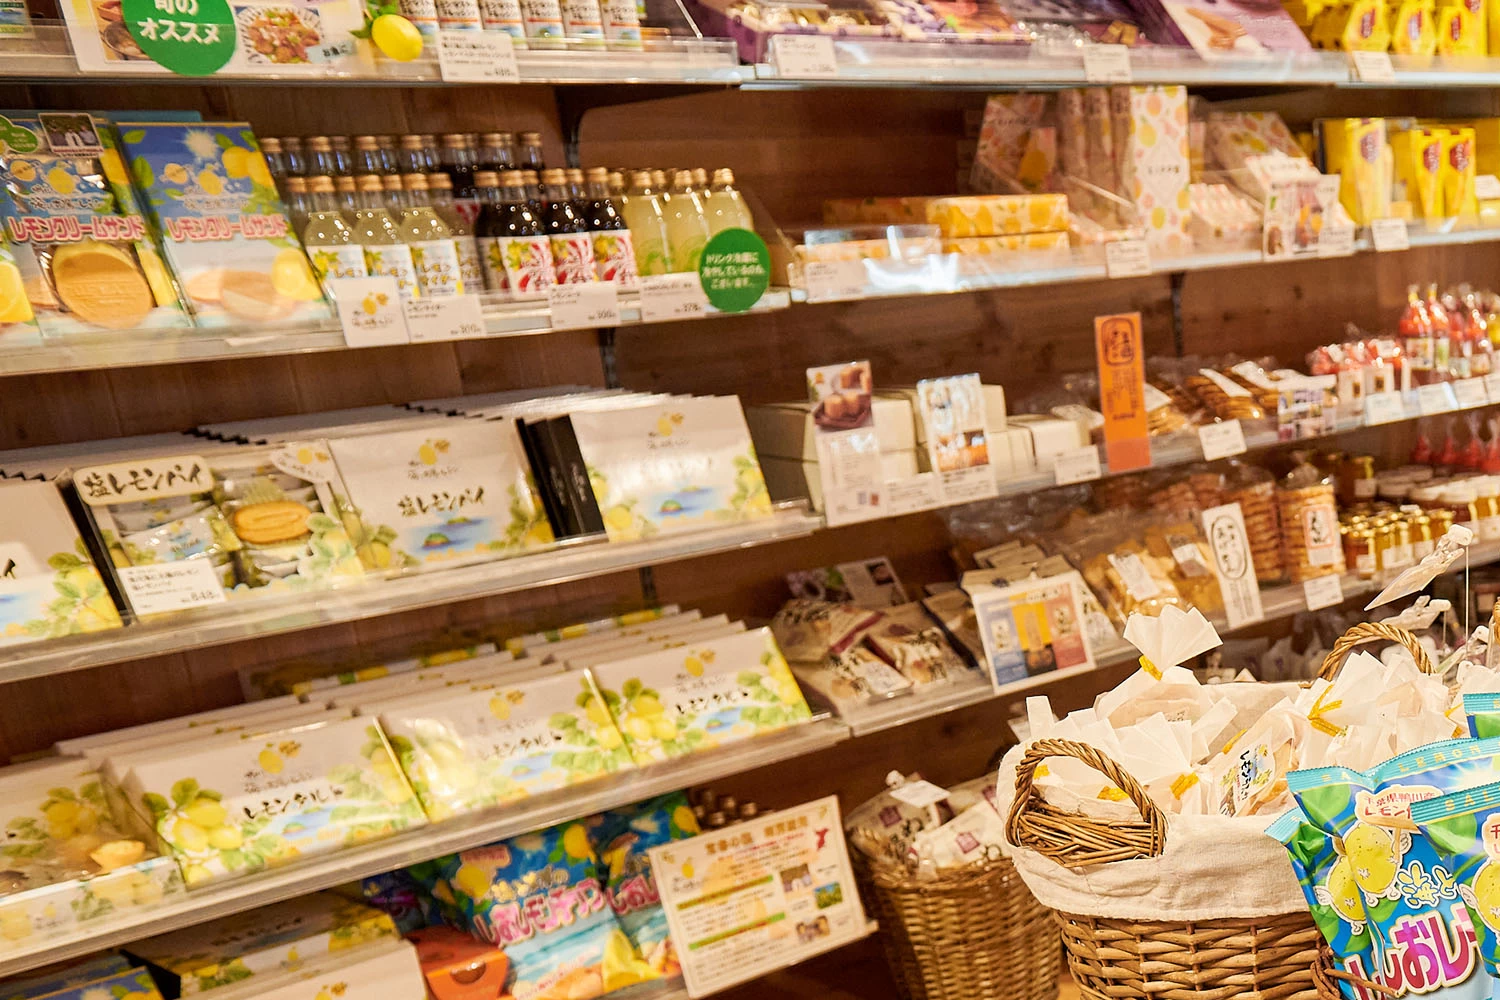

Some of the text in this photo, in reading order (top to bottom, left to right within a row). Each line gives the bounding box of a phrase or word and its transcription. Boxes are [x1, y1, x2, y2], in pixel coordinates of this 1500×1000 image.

[137, 18, 221, 45] オススメ
[8, 216, 147, 243] レモンクリームサンド
[163, 215, 289, 242] レモンクリームサンド
[83, 463, 202, 498] 塩レモンパイ
[397, 486, 485, 517] 塩レモンパイ
